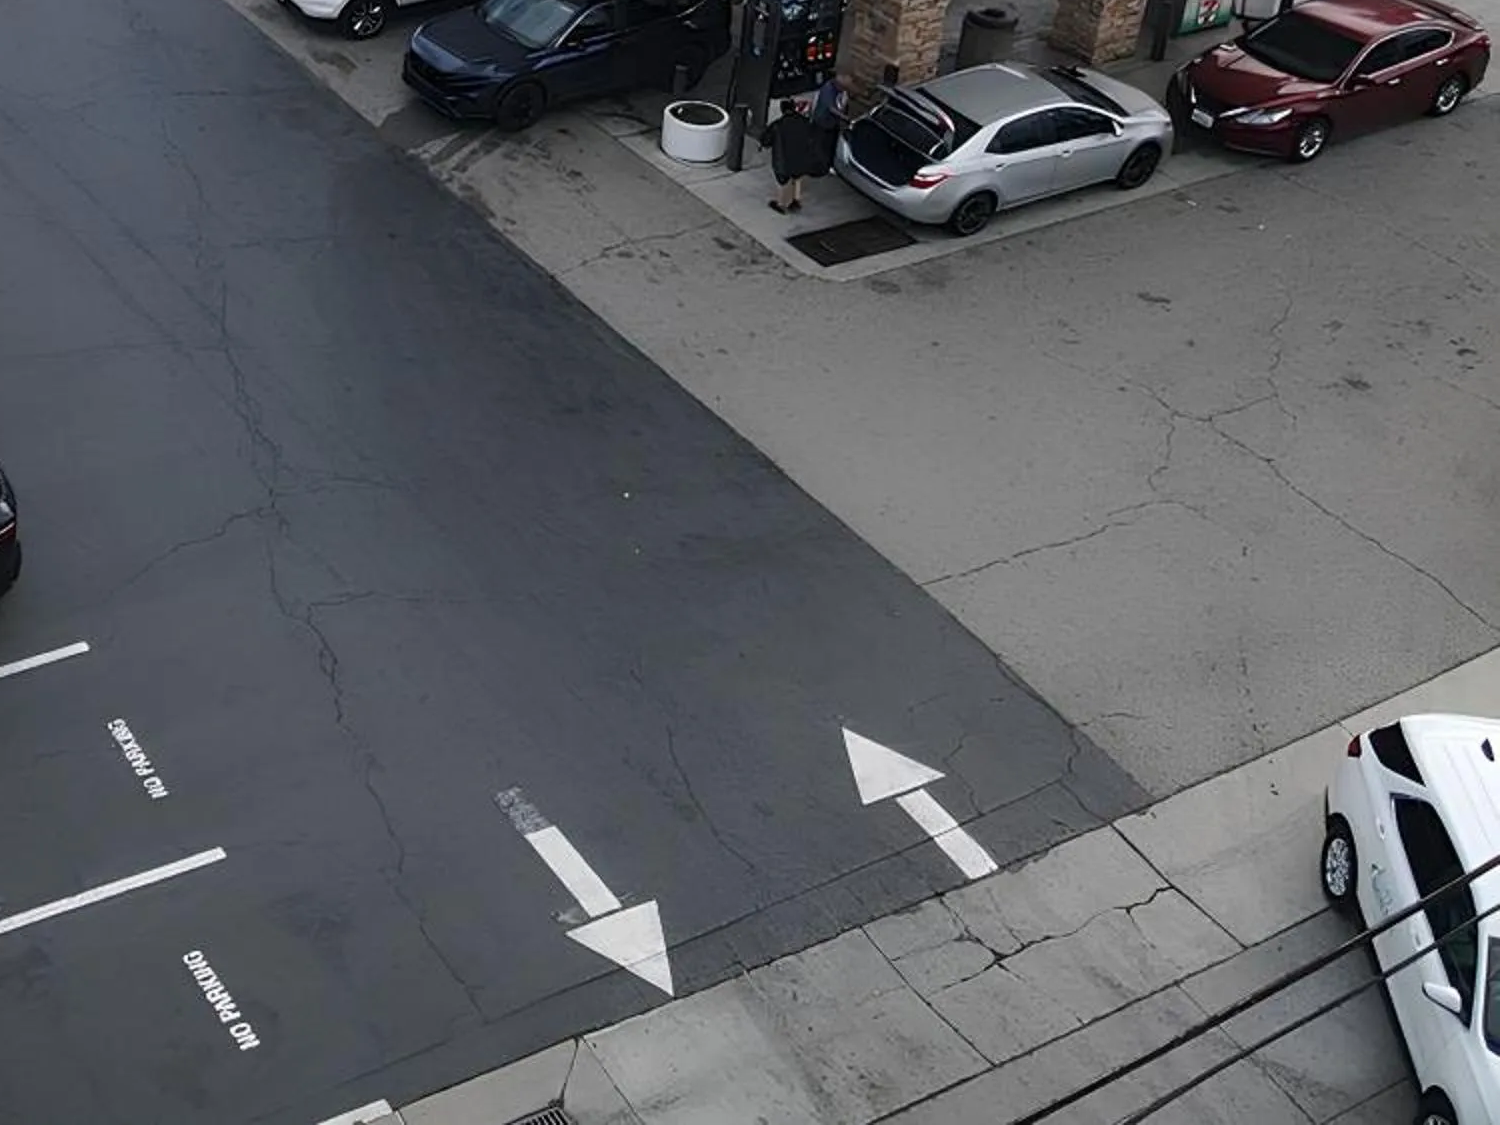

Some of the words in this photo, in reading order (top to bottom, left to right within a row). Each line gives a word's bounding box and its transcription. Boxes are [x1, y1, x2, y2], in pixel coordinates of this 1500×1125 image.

[107, 718, 155, 776] PARKING
[143, 776, 169, 799] NO
[183, 950, 241, 1023] PARKING
[230, 1022, 260, 1051] NO
